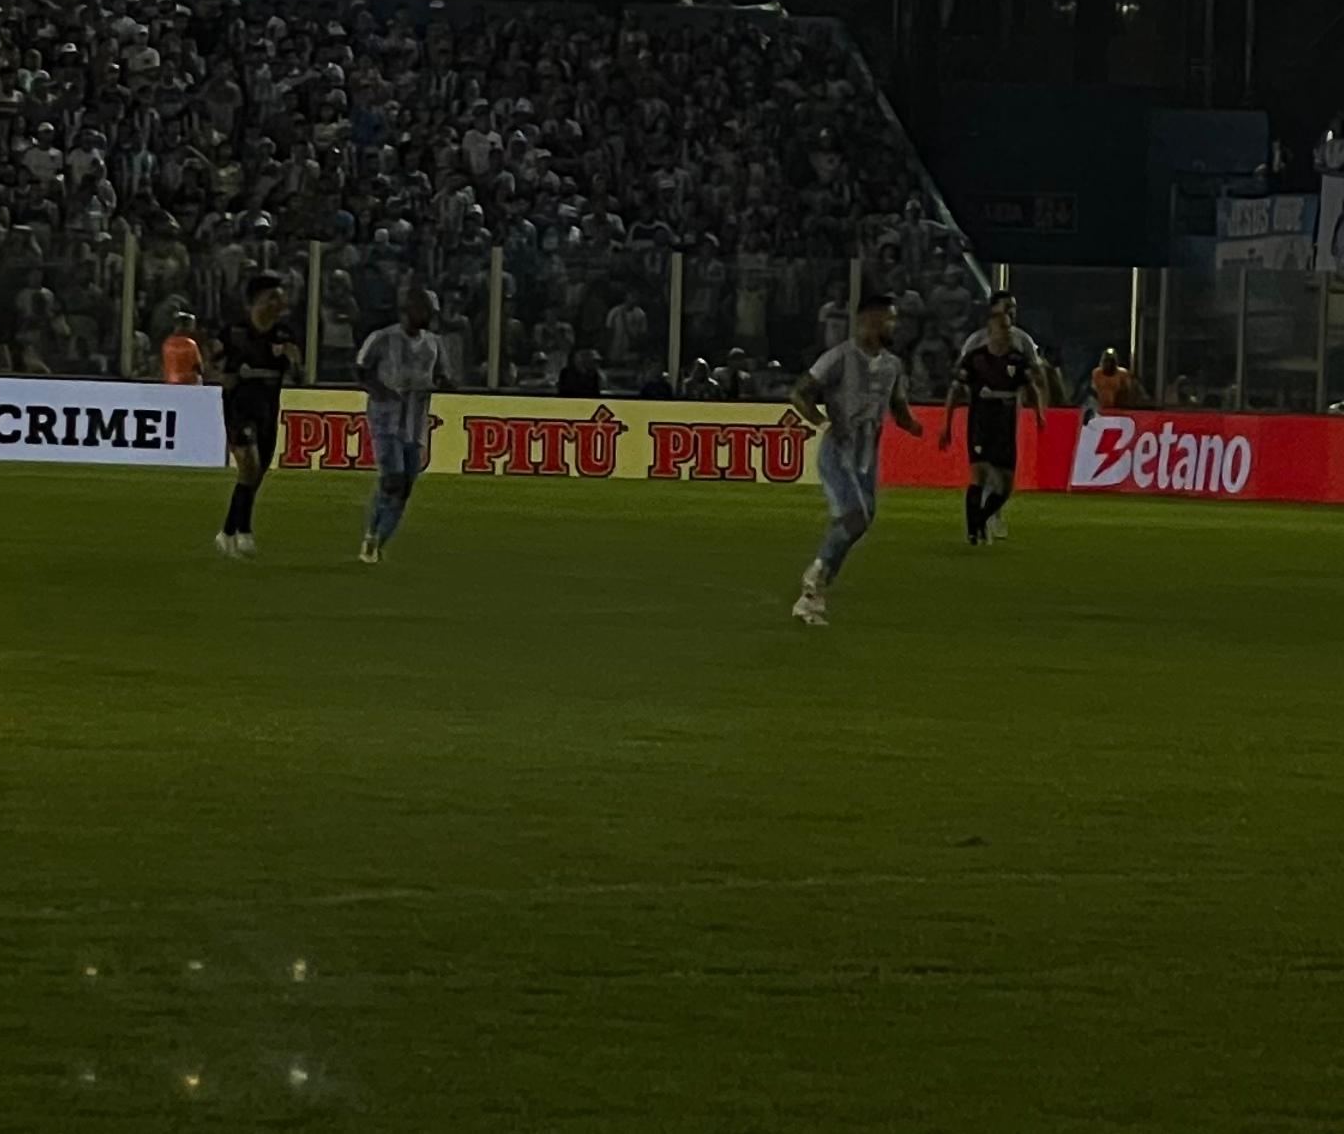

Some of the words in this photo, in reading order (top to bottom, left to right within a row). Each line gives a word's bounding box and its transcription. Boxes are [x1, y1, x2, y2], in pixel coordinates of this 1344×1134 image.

[462, 404, 628, 478] PITÚ
[648, 408, 816, 482] PITÚ
[1071, 416, 1251, 494] Betano
